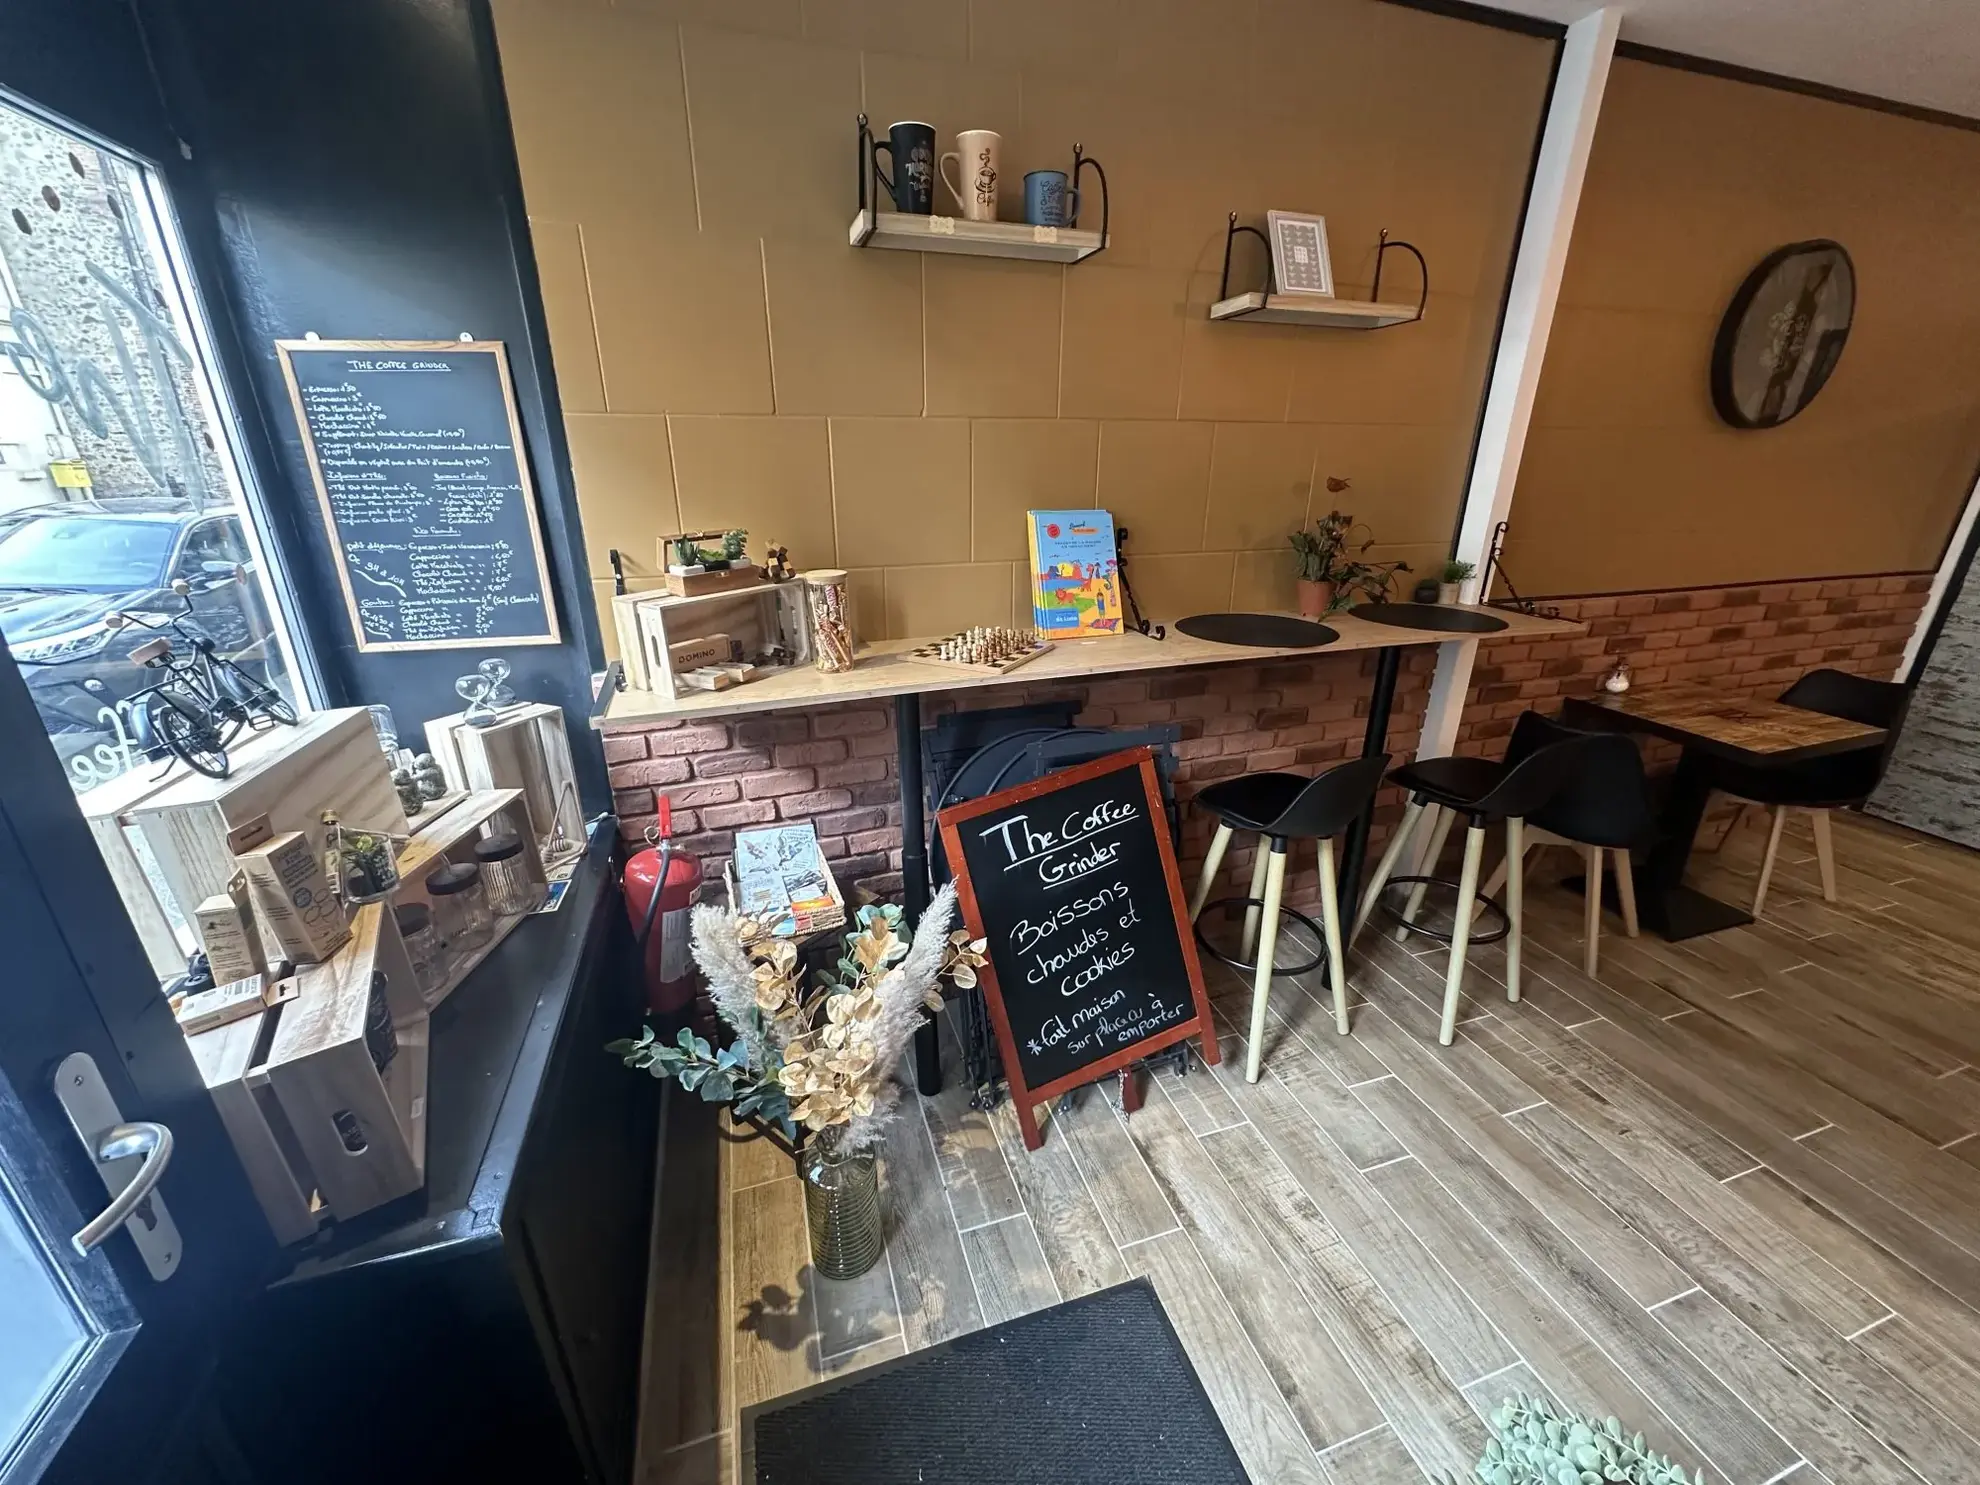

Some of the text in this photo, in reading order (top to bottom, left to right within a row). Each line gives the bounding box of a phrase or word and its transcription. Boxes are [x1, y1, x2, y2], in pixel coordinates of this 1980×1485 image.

[346, 360, 373, 369] THE
[375, 361, 407, 369] COFFEE
[678, 648, 716, 664] DOMINO
[979, 800, 1136, 863] The Coffee
[1038, 842, 1121, 884] Grinder
[1009, 880, 1129, 955] Boissons
[1027, 899, 1142, 985] chaudes et
[1117, 1003, 1185, 1042] emporter
